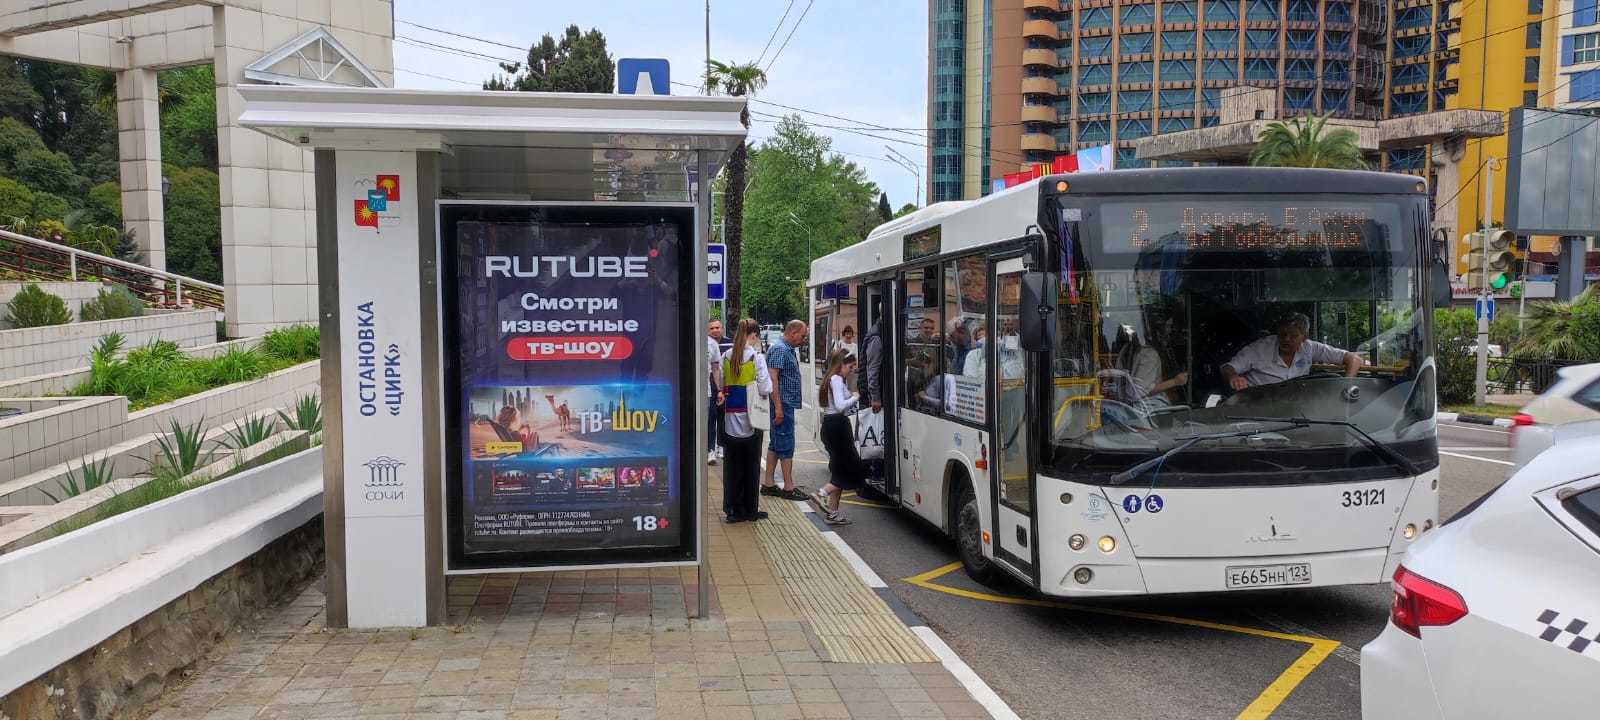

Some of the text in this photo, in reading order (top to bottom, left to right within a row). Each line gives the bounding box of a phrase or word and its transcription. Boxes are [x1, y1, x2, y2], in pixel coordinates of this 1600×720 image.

[1131, 209, 1149, 248] 2
[485, 255, 649, 279] RUTUBE
[520, 292, 618, 314] Смотри
[501, 318, 639, 333] известные
[357, 300, 377, 417] ОСТАНОВКА
[526, 341, 615, 359] тв-шоу
[385, 343, 405, 417] «ЦИРК»
[365, 491, 404, 501] СОЧИ
[1342, 488, 1385, 508] 33121
[632, 515, 669, 532] 18+
[1232, 565, 1309, 585] Е665НН 123
